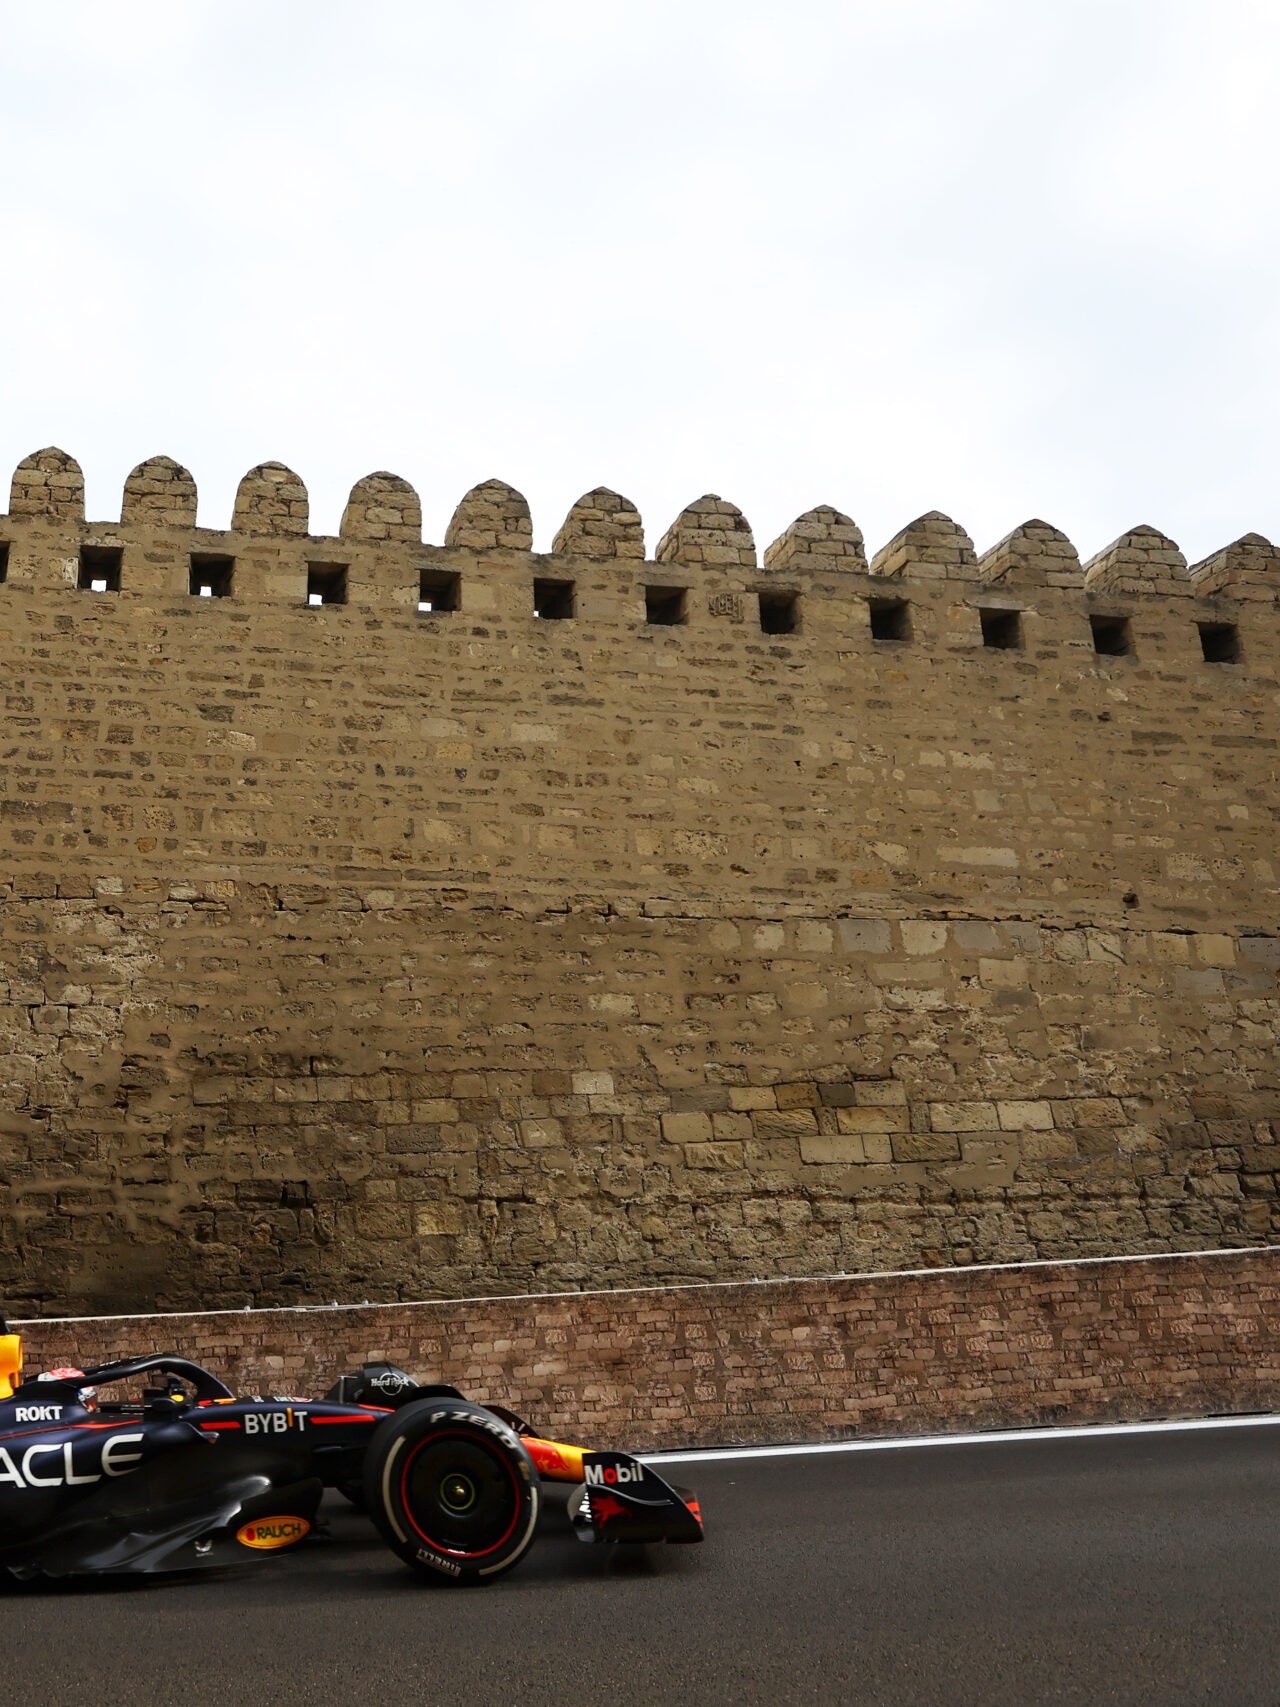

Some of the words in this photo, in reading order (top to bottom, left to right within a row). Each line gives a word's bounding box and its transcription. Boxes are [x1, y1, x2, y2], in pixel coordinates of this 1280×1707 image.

[371, 1377, 389, 1387] Hard
[15, 1405, 63, 1422] ROKT
[244, 1407, 308, 1434] BYBIT
[430, 1411, 447, 1423] P
[450, 1411, 518, 1450] ZERO
[584, 1462, 644, 1485] Mobil
[256, 1523, 301, 1541] RAUCH
